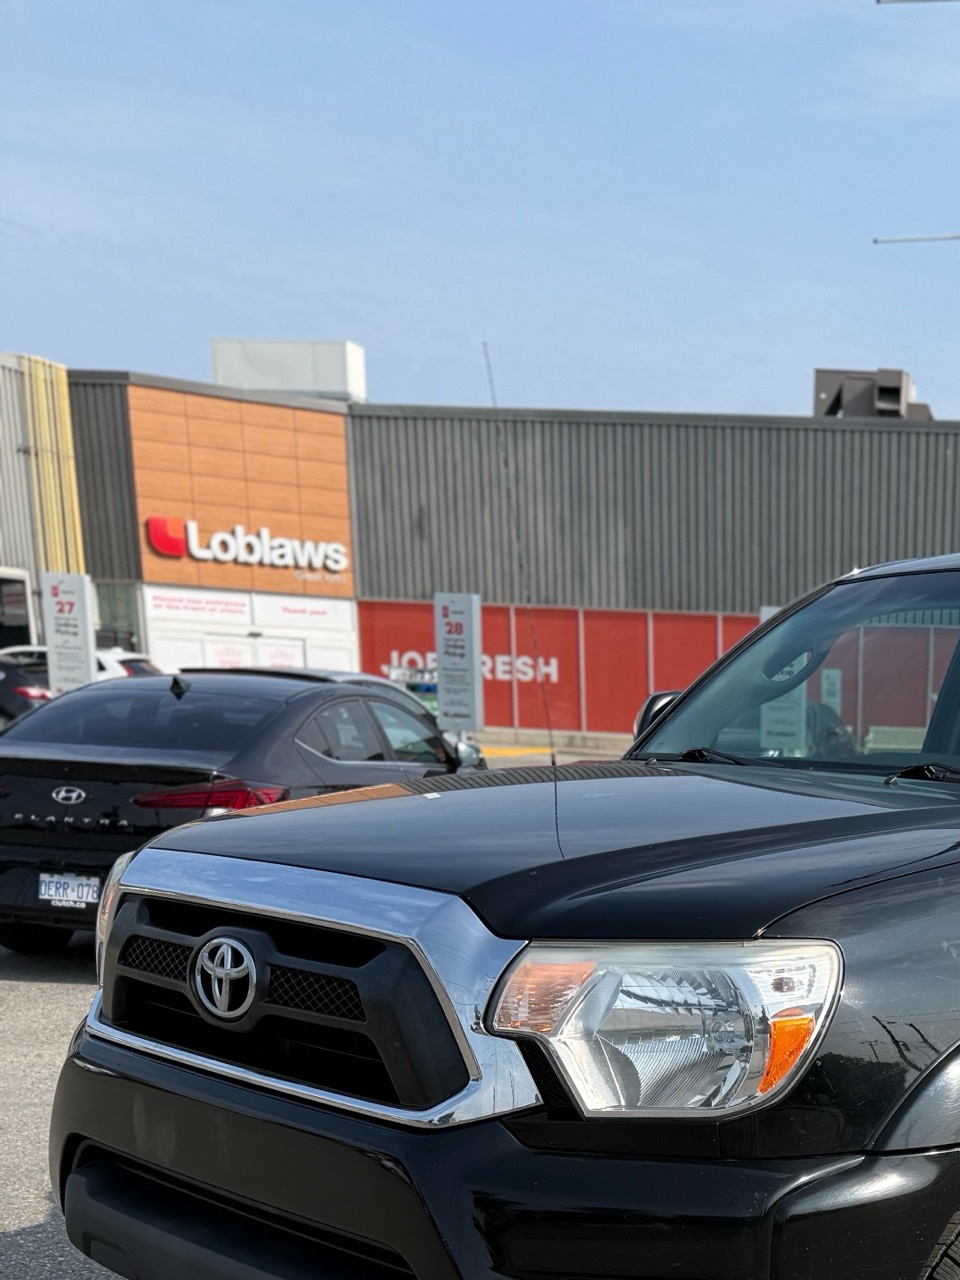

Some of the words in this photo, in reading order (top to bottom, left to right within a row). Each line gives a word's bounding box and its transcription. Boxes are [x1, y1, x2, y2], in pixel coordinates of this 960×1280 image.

[186, 519, 349, 572] Loblaws
[55, 600, 75, 615] 27
[445, 621, 464, 636] 28
[481, 653, 559, 684] RESH
[14, 813, 129, 826] ELANTRA
[76, 883, 100, 901] 078
[51, 900, 86, 909] clutch.co
